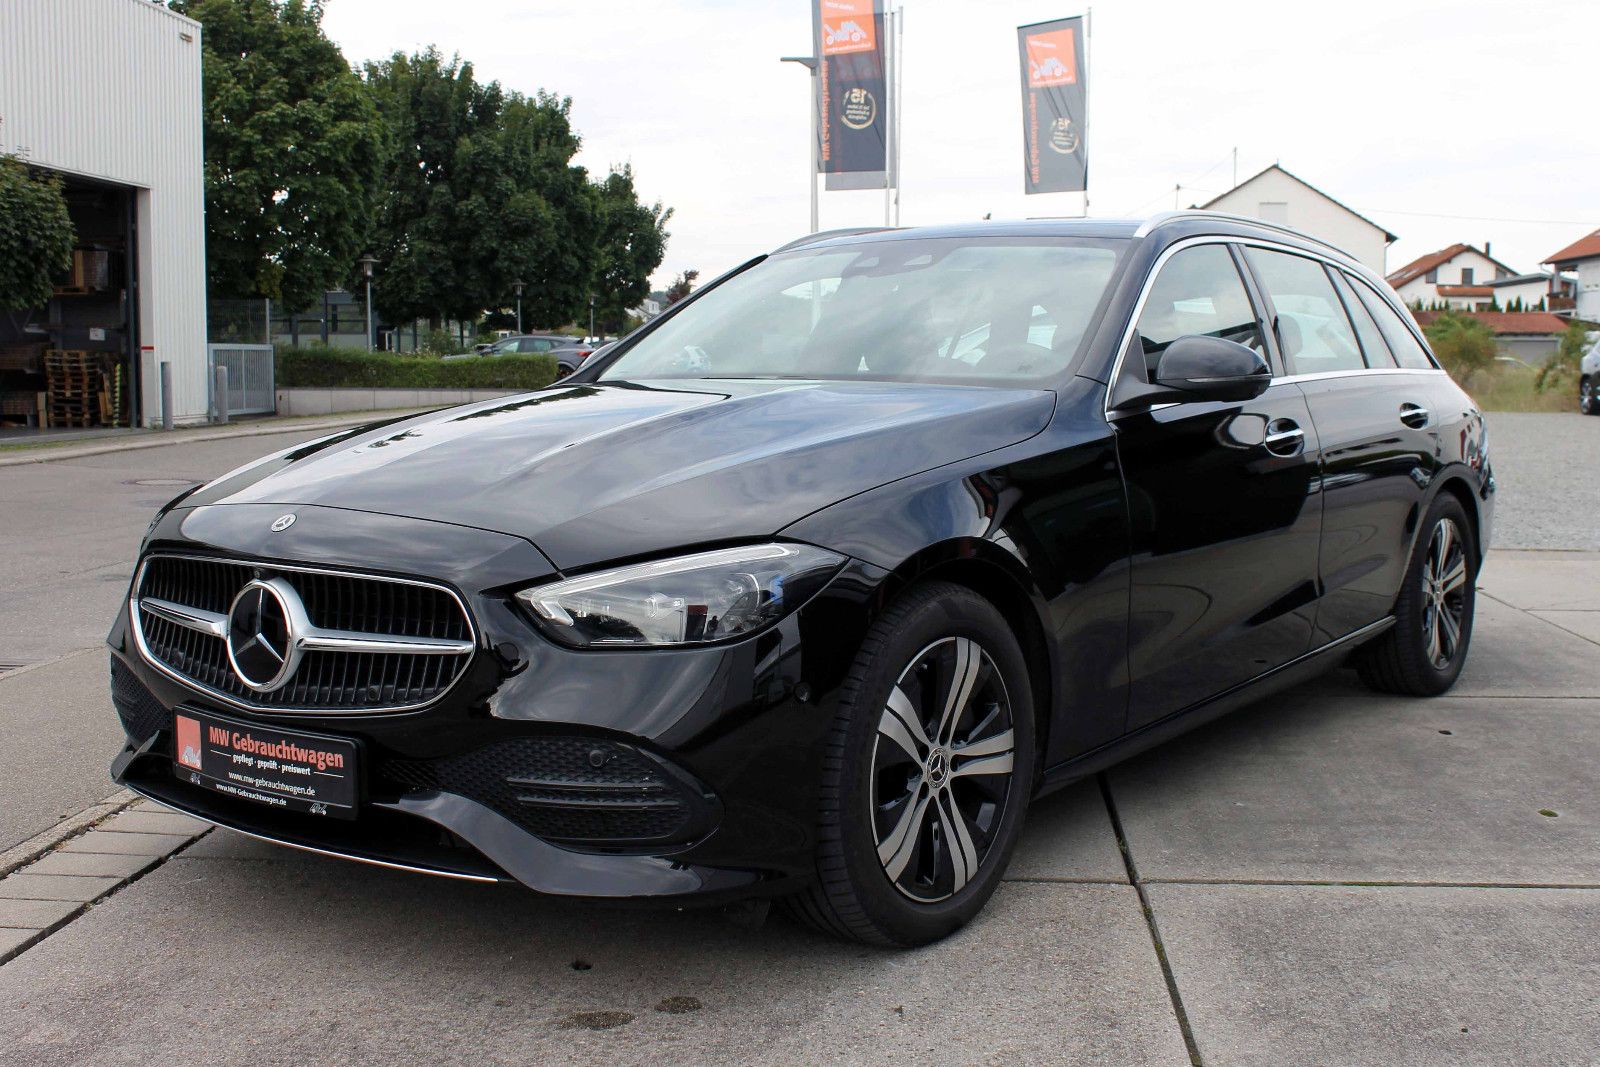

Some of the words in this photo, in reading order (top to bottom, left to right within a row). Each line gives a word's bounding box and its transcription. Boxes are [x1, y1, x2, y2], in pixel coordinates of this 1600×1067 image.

[210, 726, 230, 747] MW
[232, 732, 344, 770] Gebrauchtwagen
[233, 753, 254, 766] gepflegt
[257, 758, 278, 770] geprüft
[281, 764, 311, 776] preiswert
[216, 783, 287, 806] www.MW-Gebrauchtwagen.de
[229, 772, 315, 796] www.mw-gebrauchtwagen.de
